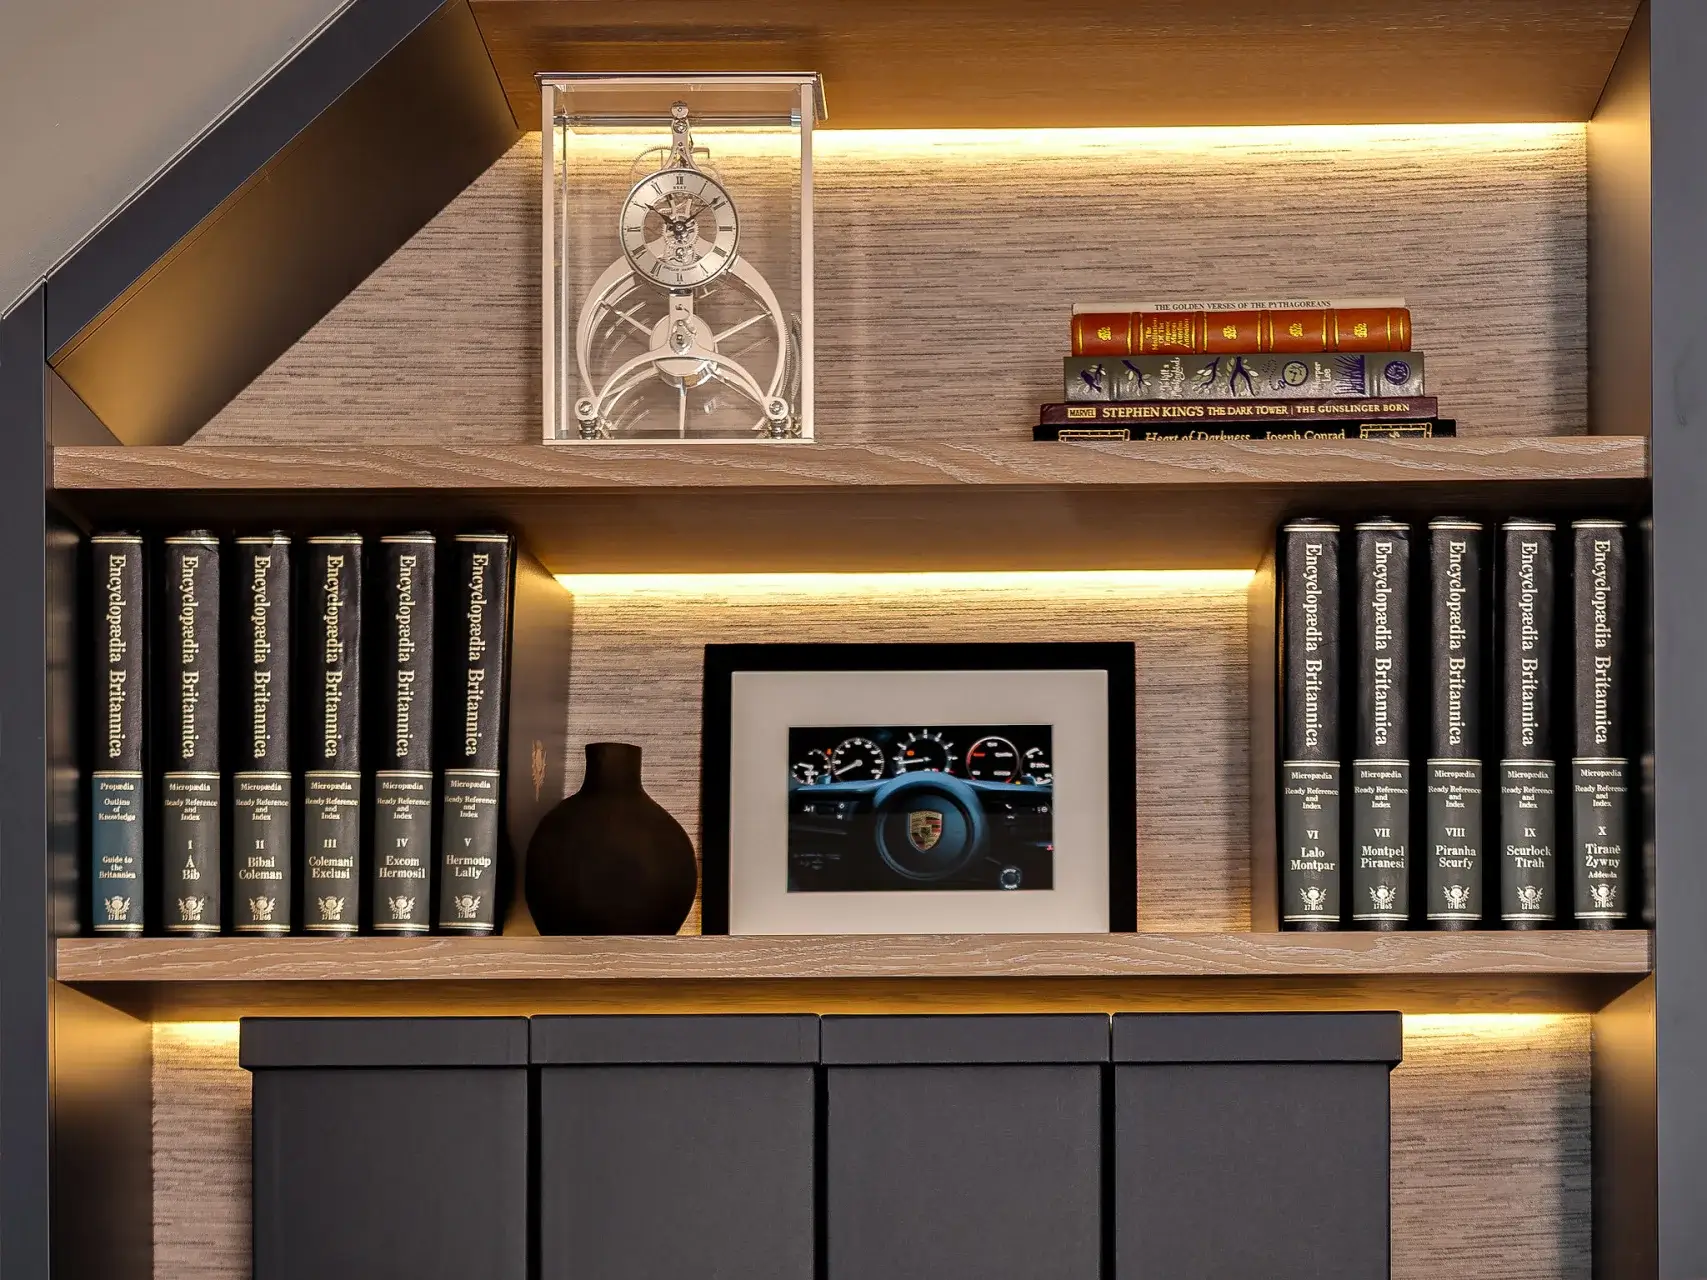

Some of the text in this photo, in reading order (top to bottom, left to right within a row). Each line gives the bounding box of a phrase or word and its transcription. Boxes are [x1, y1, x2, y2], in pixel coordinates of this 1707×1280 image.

[1172, 303, 1205, 311] GOLDEN
[1238, 302, 1248, 310] OF
[1268, 300, 1331, 309] PYTHAGOREANS
[1321, 368, 1332, 382] Lee
[1069, 408, 1096, 417] MARVEL
[1102, 403, 1410, 418] STEPHEN KING'S THE DARK TOWER THE GUNSLINGER BORN
[1145, 430, 1251, 441] Heart of Darkness
[1304, 428, 1345, 440] Conrad
[1302, 543, 1322, 746] Encyclopædia Britannica
[1372, 541, 1392, 746] Encyclopædia Britannica
[1447, 541, 1466, 745] Encyclopædia Britannica
[1519, 541, 1538, 746] Encyclopædia Britannica
[1592, 539, 1612, 744] Encyclopædia Britannica
[106, 554, 127, 758] Encyclopædia Britannica
[179, 555, 199, 759] Encyclopædia Britannica
[251, 555, 271, 759] Encyclopædia Britannica
[323, 555, 344, 759] Encyclopædia Britannica
[396, 554, 416, 757] Encyclopædia Britannica
[465, 553, 489, 756] Encyclopædia Britannica
[1292, 772, 1332, 780] Micropædia
[1361, 771, 1402, 779] Micropædia
[1435, 770, 1475, 778] Micropædia
[1508, 771, 1548, 779] Micropædia
[1581, 769, 1622, 777] Micropædia
[170, 783, 210, 791] Micropædia
[241, 783, 282, 791] Micropædia
[311, 782, 352, 790] Micropædia
[383, 782, 423, 790] Micropædia
[451, 781, 490, 789] Micropædia
[1355, 786, 1375, 794] Ready
[1450, 786, 1481, 794] Reference
[1306, 830, 1319, 839] VI
[1374, 828, 1391, 837] VII
[1445, 828, 1465, 837] VIII
[1525, 828, 1536, 837] IX
[1598, 826, 1607, 835] X
[188, 840, 192, 849] I
[256, 840, 264, 849] II
[324, 839, 337, 848] III
[396, 838, 408, 847] IV
[465, 838, 472, 846] V
[1301, 847, 1325, 857] Lalo
[1362, 846, 1404, 857] Montpel
[1436, 845, 1476, 856] Piranha
[1507, 845, 1551, 856] Scurlock
[248, 857, 275, 868] Bibai
[309, 856, 353, 867] Colemani
[386, 856, 419, 866] Excom
[1291, 860, 1335, 872] Montpar
[1361, 858, 1404, 868] Piranesi
[1439, 858, 1473, 869] Scurfy
[183, 870, 200, 880] Bib
[239, 871, 282, 879] Coleman
[312, 868, 350, 879] Exclusi
[379, 868, 425, 878] Hermosil
[455, 867, 482, 879] Lally
